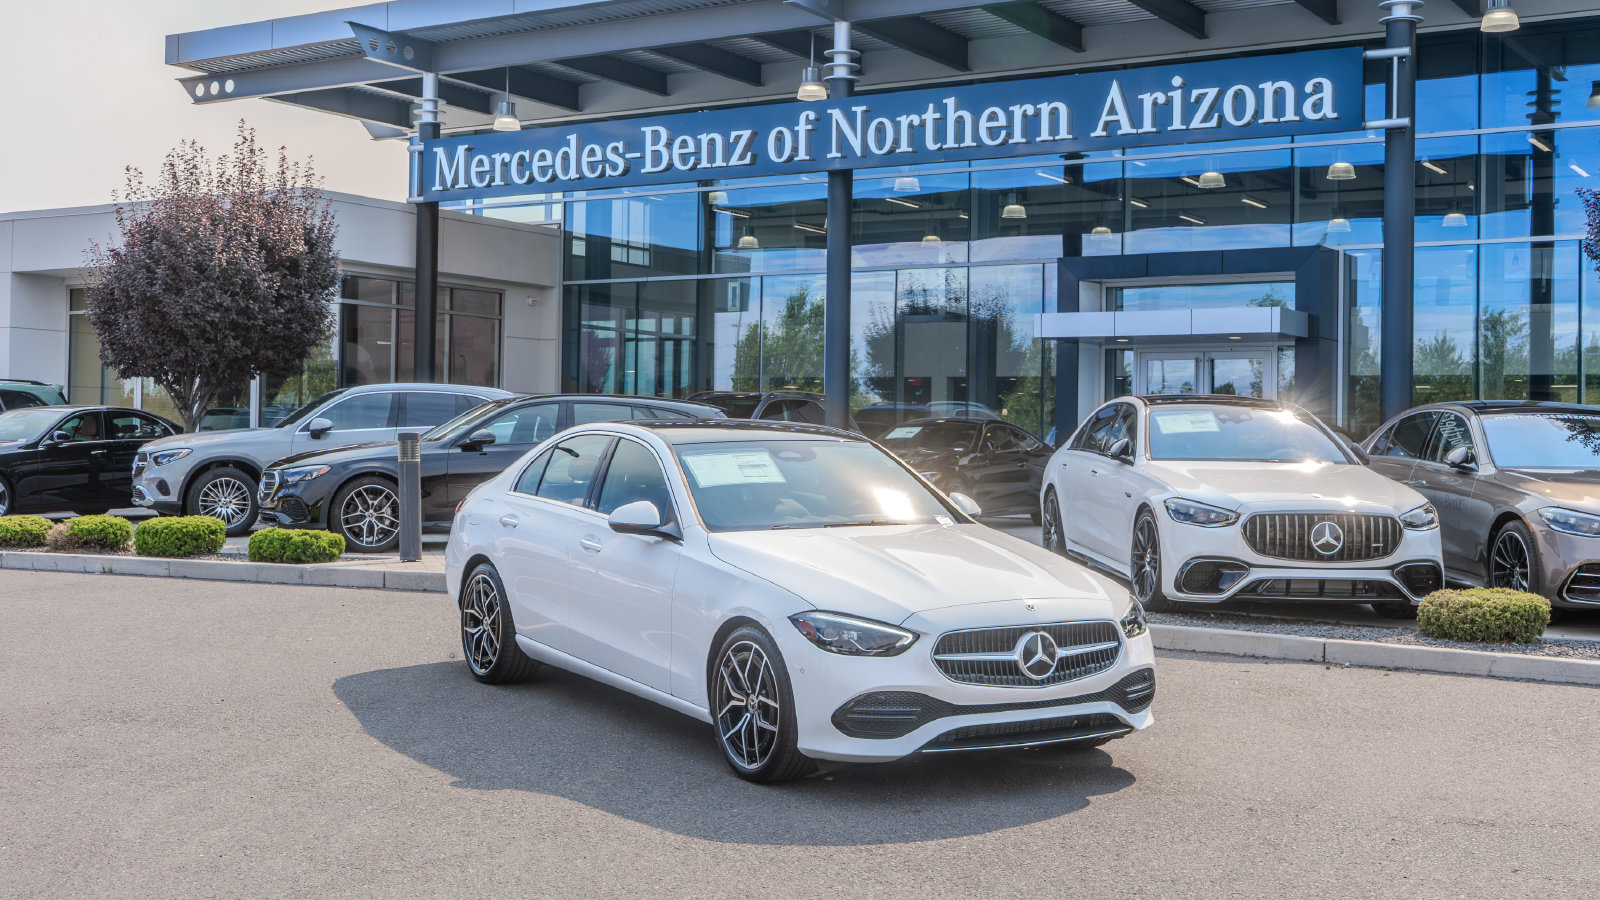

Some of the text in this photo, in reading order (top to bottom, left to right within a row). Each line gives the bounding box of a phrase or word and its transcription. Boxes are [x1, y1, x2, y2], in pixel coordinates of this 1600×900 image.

[432, 75, 1339, 192] Mercedes-Benz of Northern Arizona
